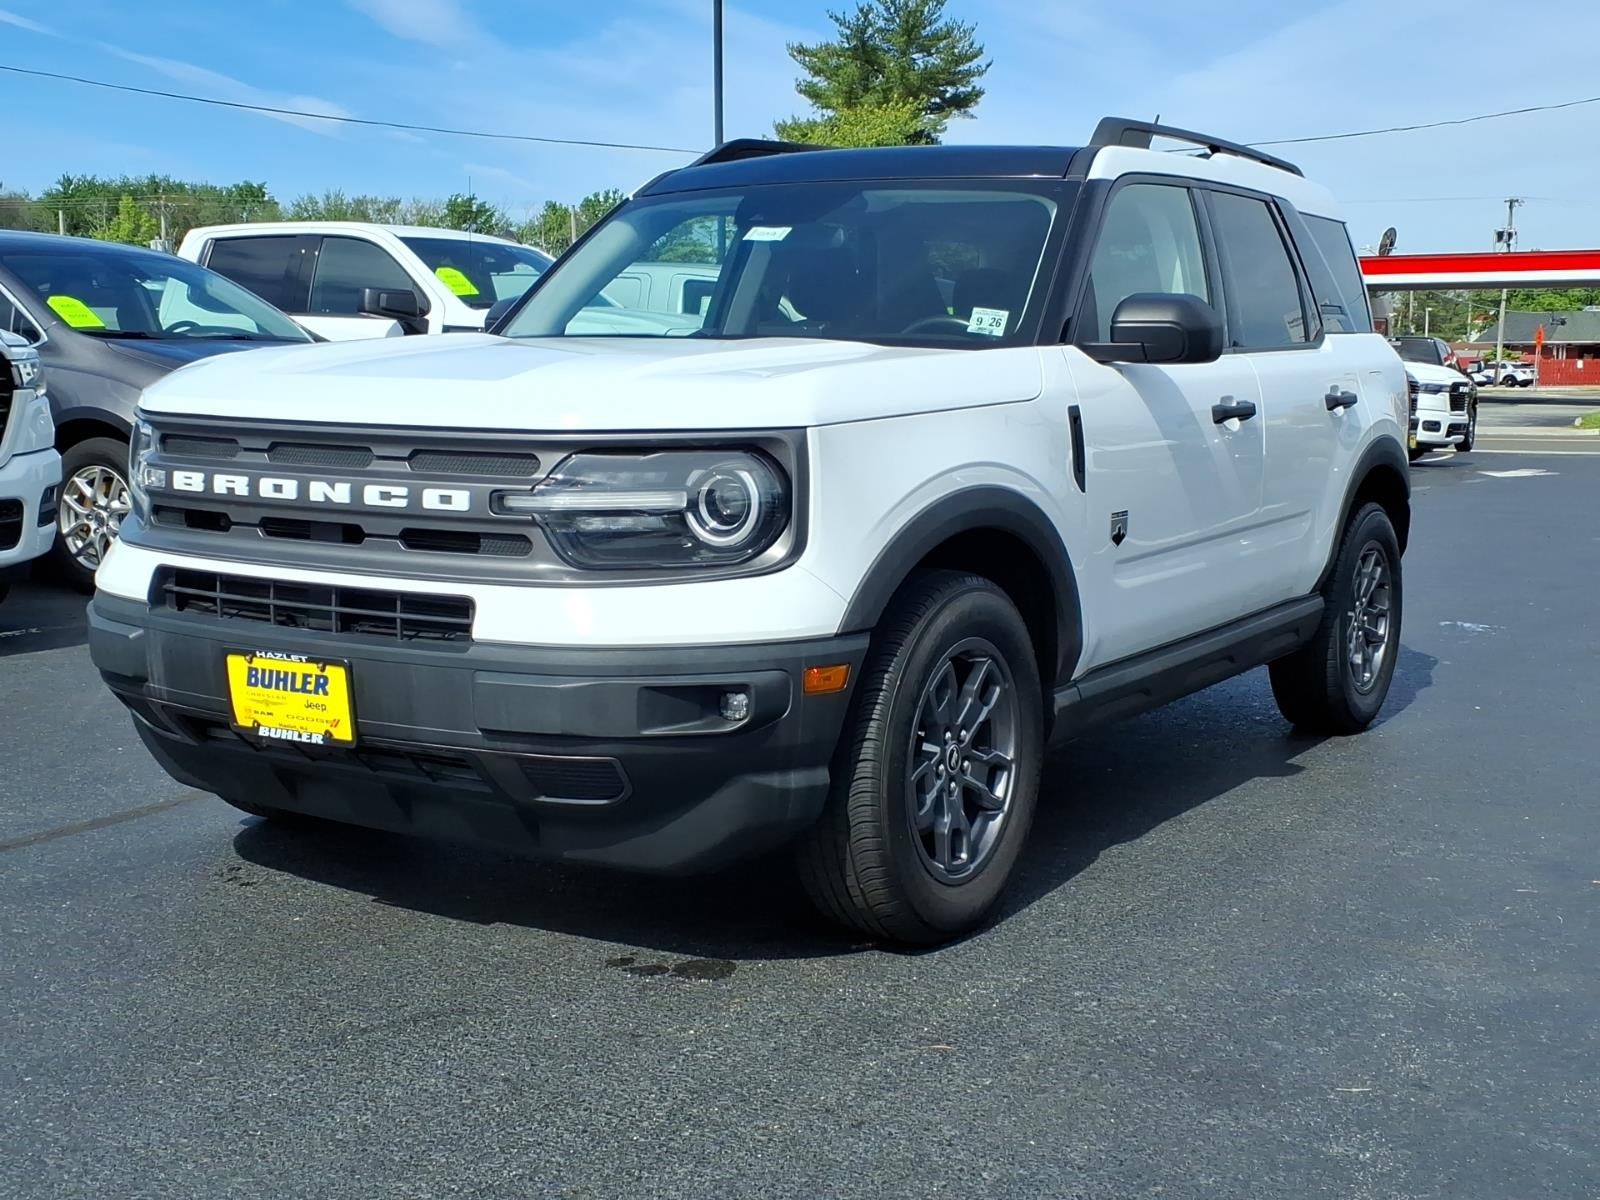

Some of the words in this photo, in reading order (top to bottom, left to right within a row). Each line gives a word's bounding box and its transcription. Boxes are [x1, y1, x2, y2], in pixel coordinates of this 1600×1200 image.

[976, 316, 983, 326] 9
[988, 317, 1002, 328] 26
[171, 469, 471, 512] BRONCO
[255, 650, 308, 663] HAZLET
[246, 666, 329, 696] BUHLER
[304, 699, 327, 713] Jeep
[258, 727, 325, 745] BUHLER
